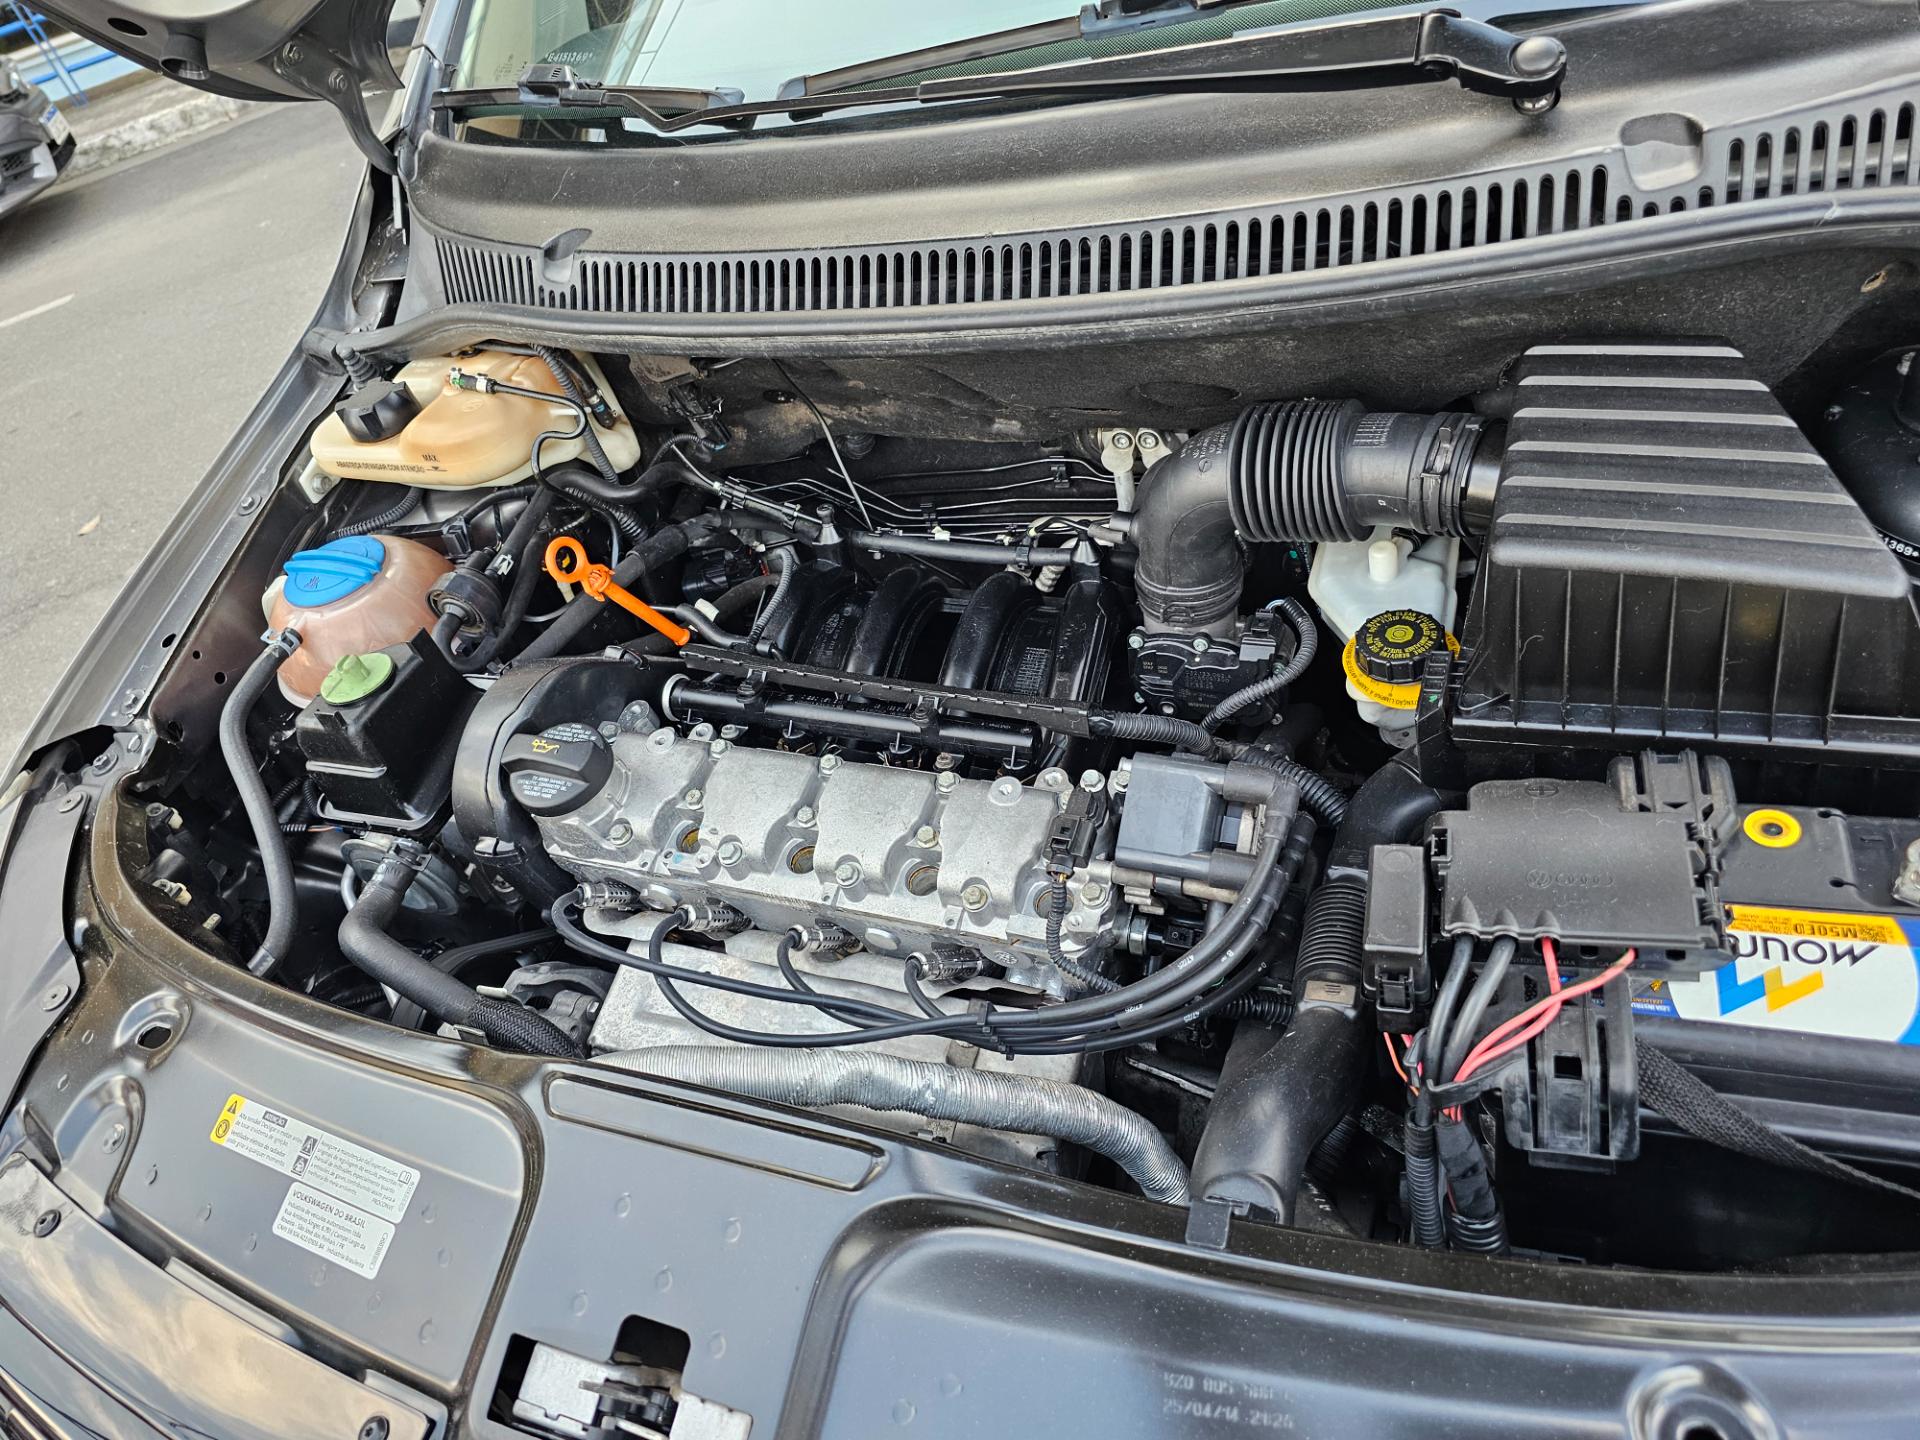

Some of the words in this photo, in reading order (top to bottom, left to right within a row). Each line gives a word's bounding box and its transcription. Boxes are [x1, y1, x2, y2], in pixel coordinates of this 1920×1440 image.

[292, 1189, 335, 1214] VOLKSWAGEN
[334, 1208, 345, 1218] DO
[344, 1213, 367, 1229] BRASIL
